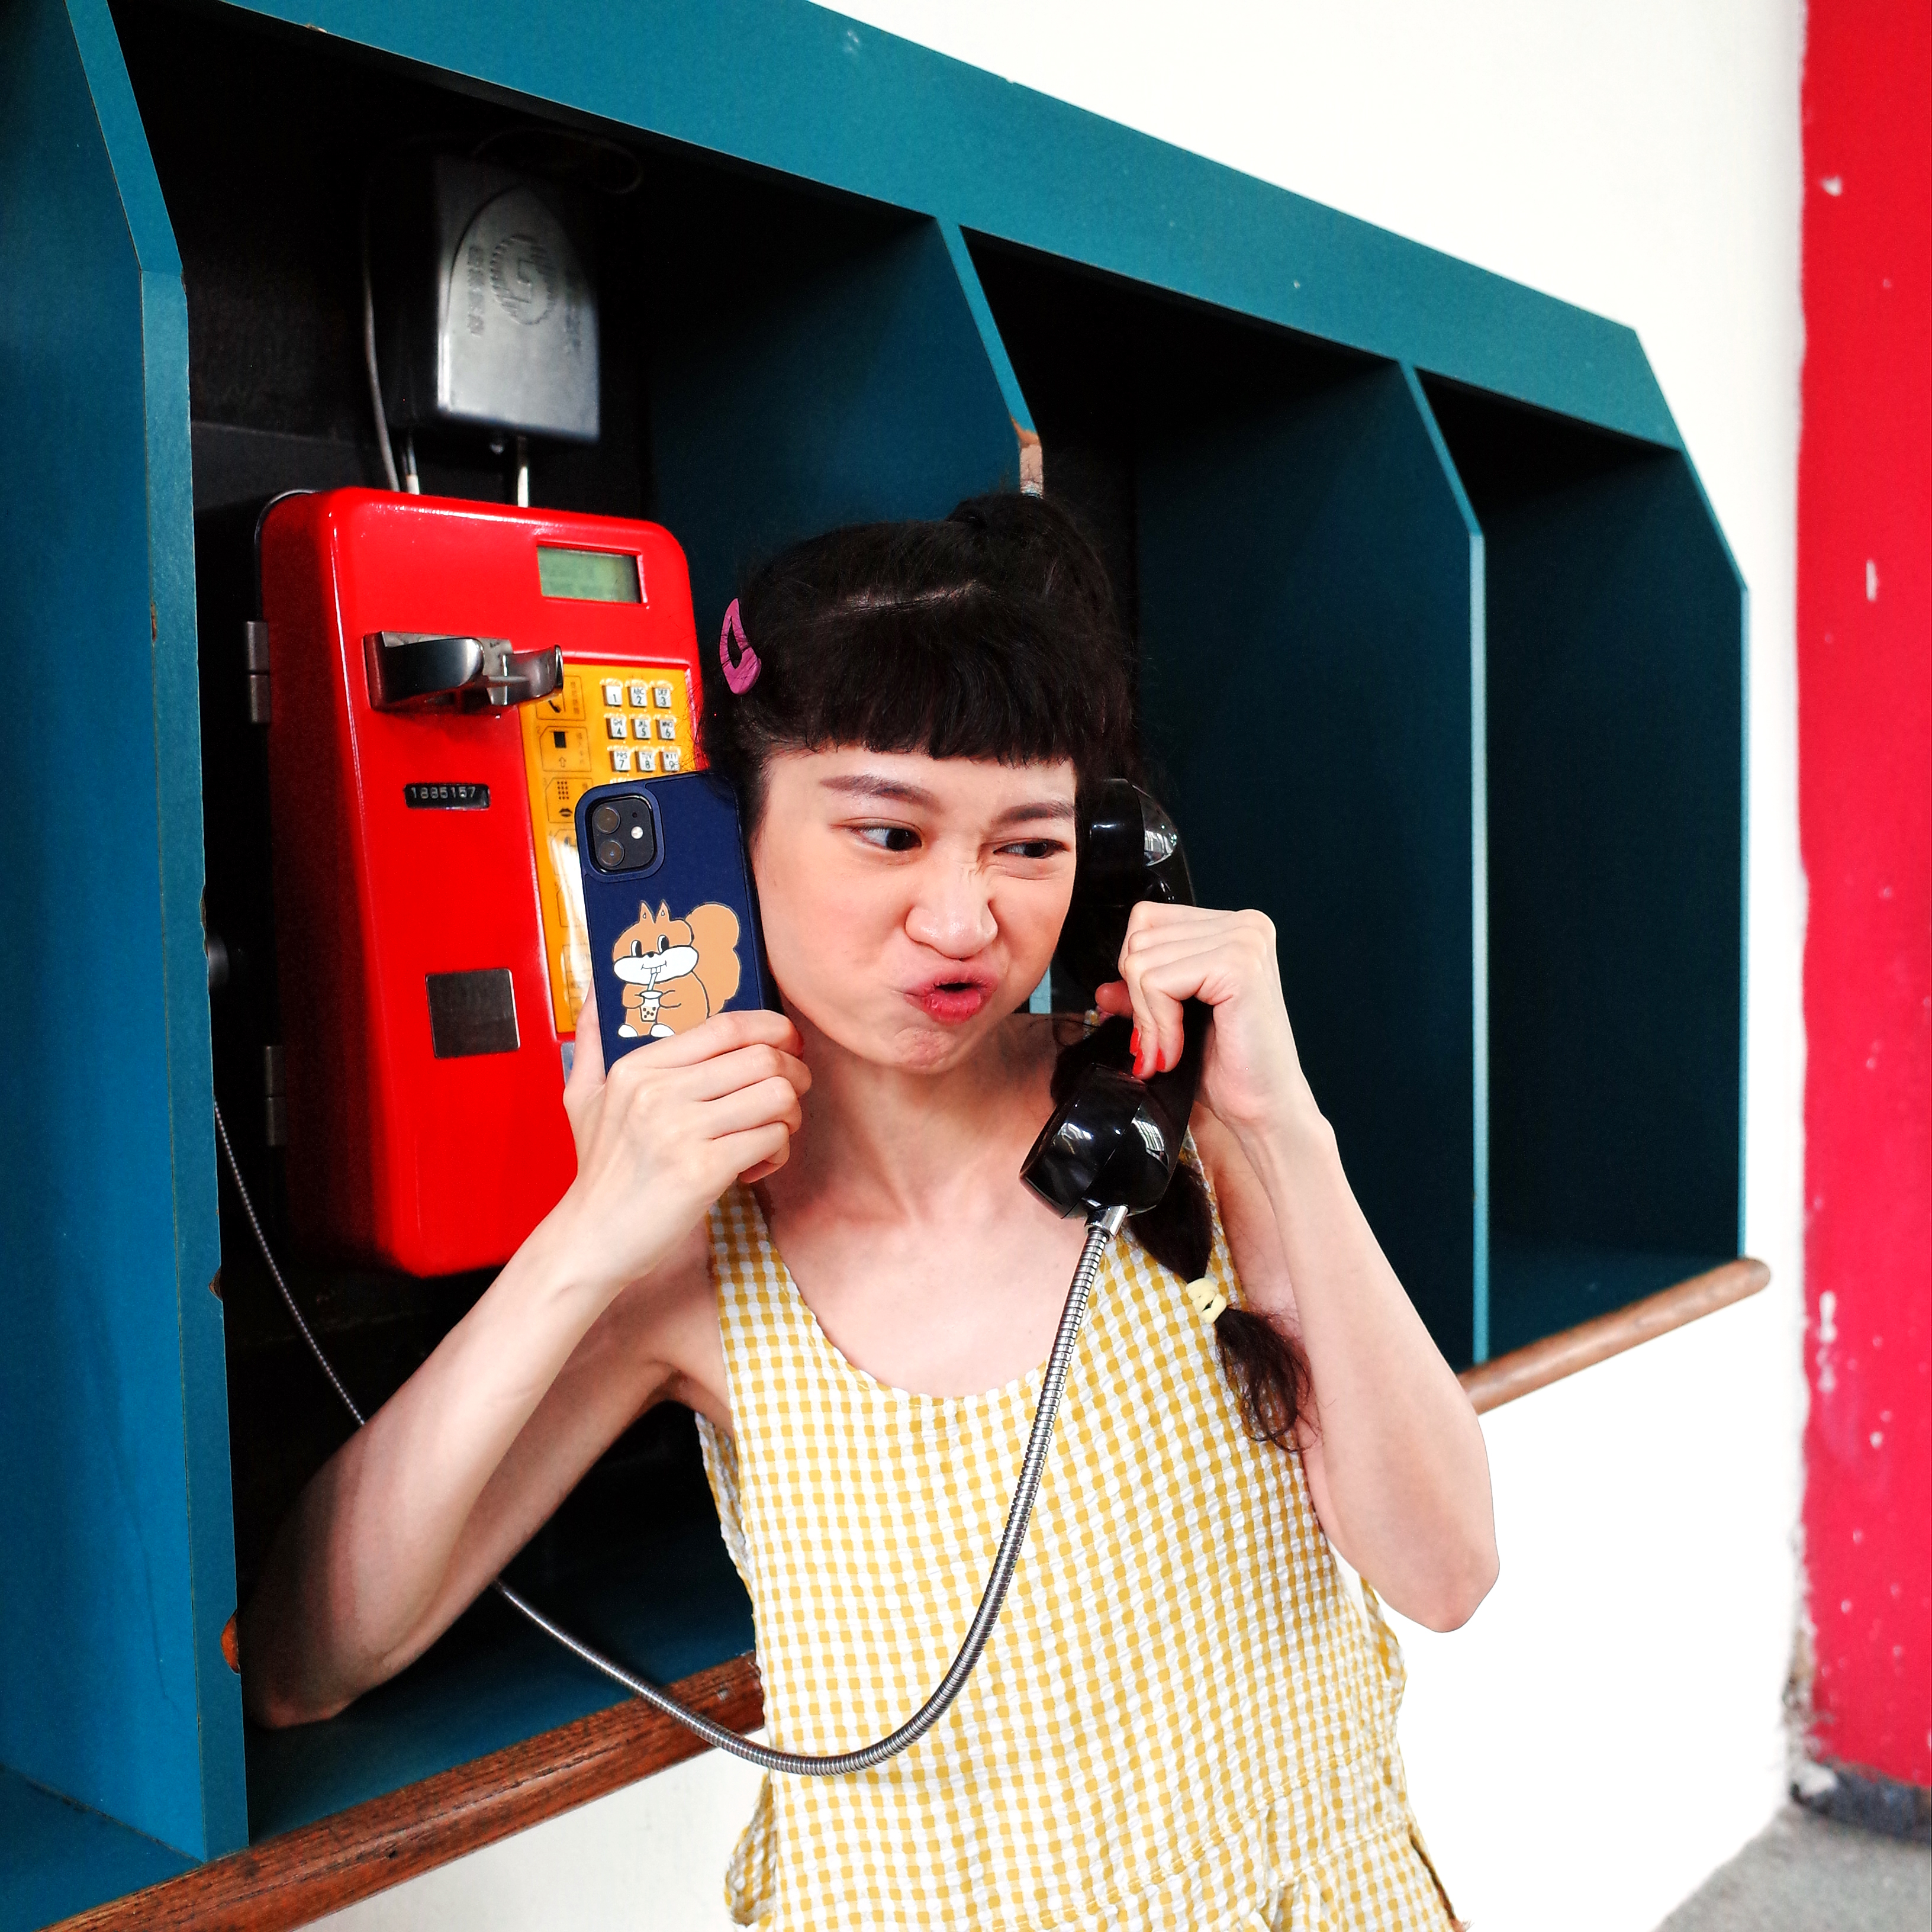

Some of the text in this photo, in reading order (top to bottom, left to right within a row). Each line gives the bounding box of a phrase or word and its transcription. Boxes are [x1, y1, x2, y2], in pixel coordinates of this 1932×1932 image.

[613, 694, 617, 703] 1
[636, 695, 642, 704] 2
[661, 697, 666, 706] 3
[617, 727, 622, 736] 4
[642, 727, 646, 736] 5
[665, 728, 671, 738] 6
[619, 759, 624, 769] 7
[645, 760, 651, 769] 8
[669, 761, 675, 769] 9
